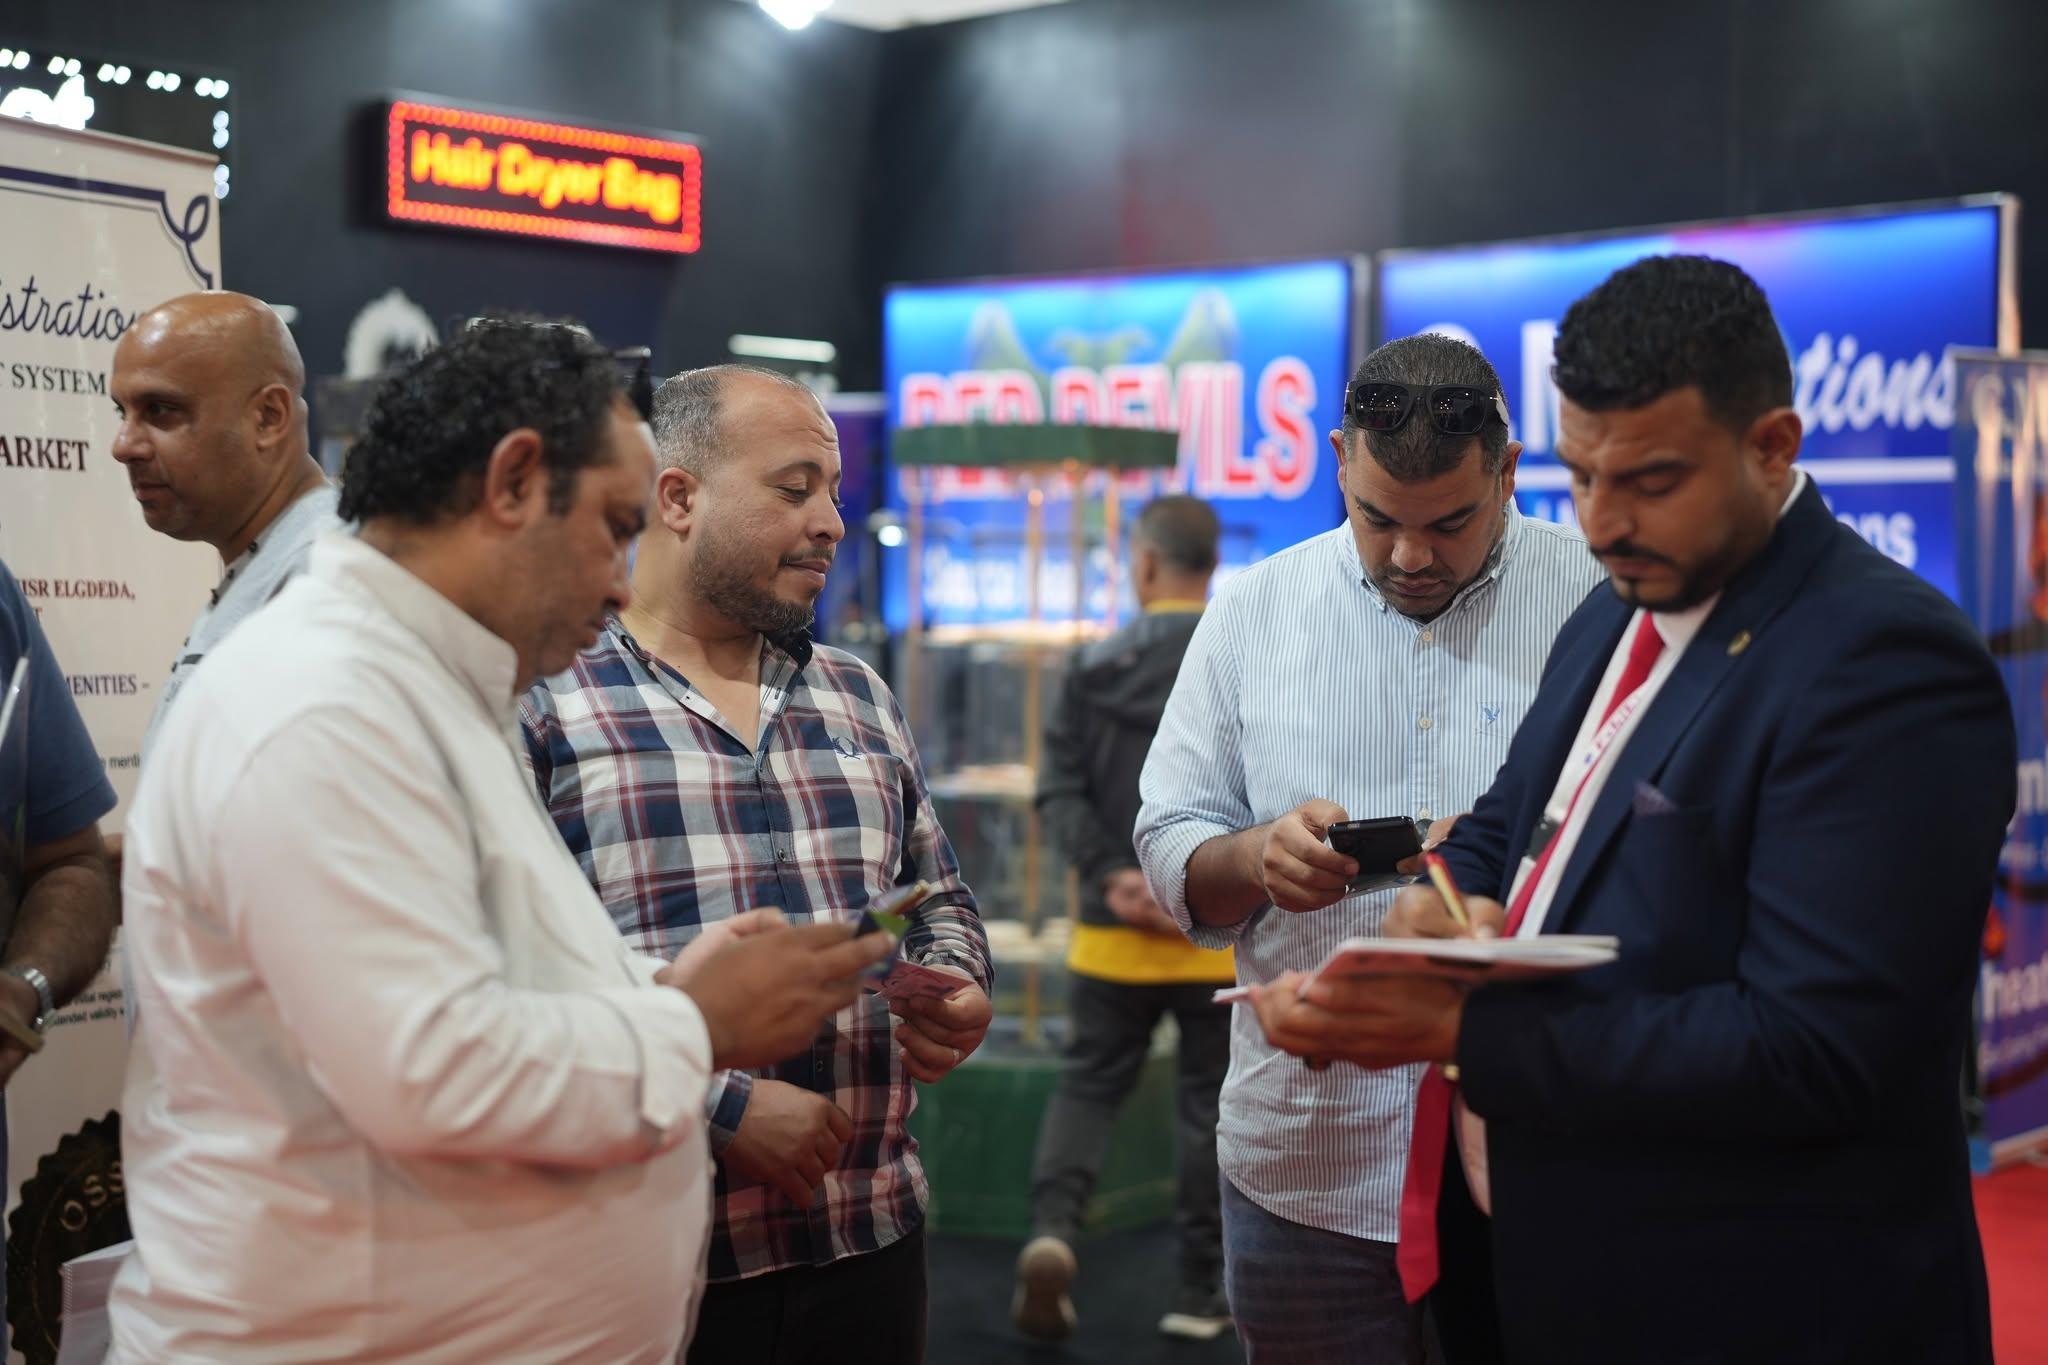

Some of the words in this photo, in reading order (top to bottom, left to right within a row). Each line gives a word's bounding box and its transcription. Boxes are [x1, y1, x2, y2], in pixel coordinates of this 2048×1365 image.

[411, 129, 496, 191] Hair
[0, 275, 135, 341] stratio
[12, 363, 107, 395] SYSTEM
[1793, 332, 1955, 437] tions
[0, 434, 90, 471] ARKET
[21, 579, 50, 598] ISR
